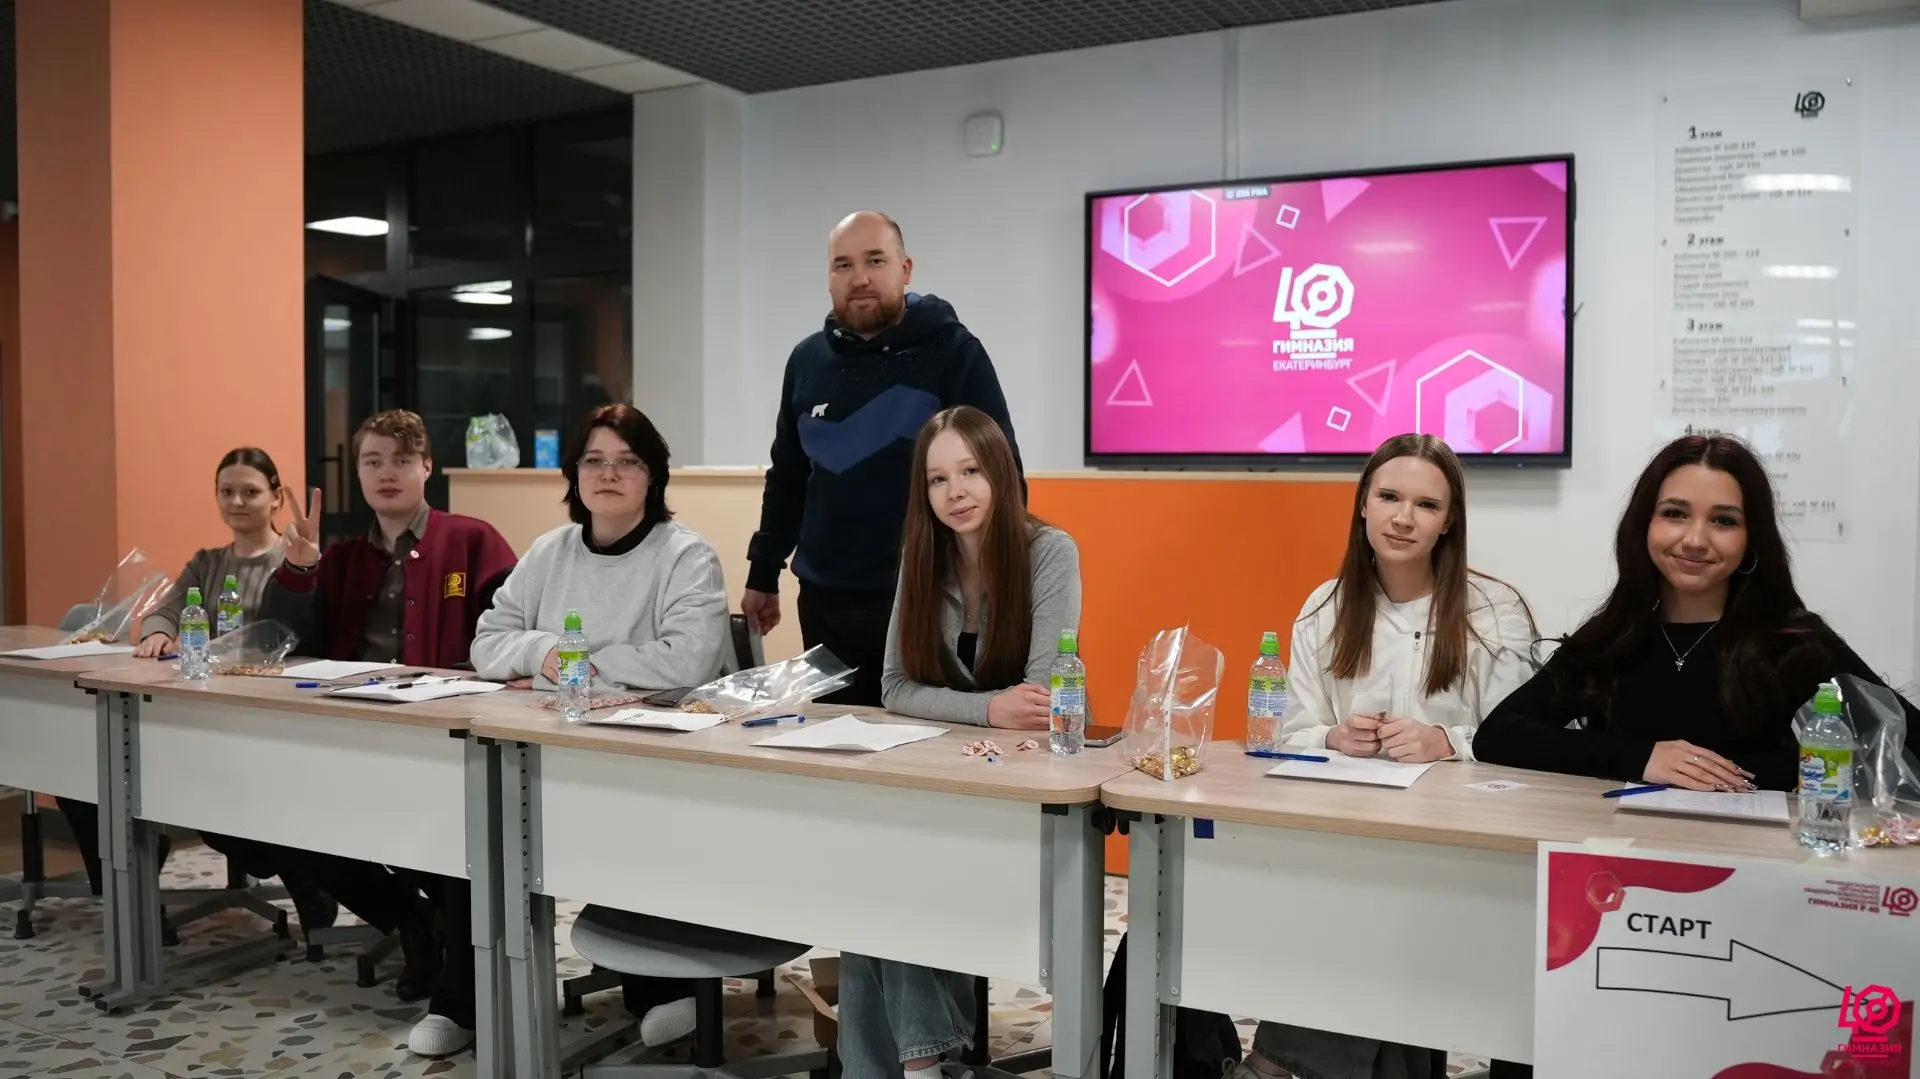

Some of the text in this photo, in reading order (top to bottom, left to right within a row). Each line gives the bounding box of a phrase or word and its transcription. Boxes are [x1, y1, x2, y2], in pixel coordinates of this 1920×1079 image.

[1689, 126, 1697, 139] 1
[1687, 233, 1695, 246] 2
[1687, 318, 1694, 331] 3
[1273, 338, 1355, 353] ГИМНАЗИЯ
[1273, 358, 1353, 371] ЕКАТЕРИНБУРГ
[1626, 912, 1712, 940] СТАРТ
